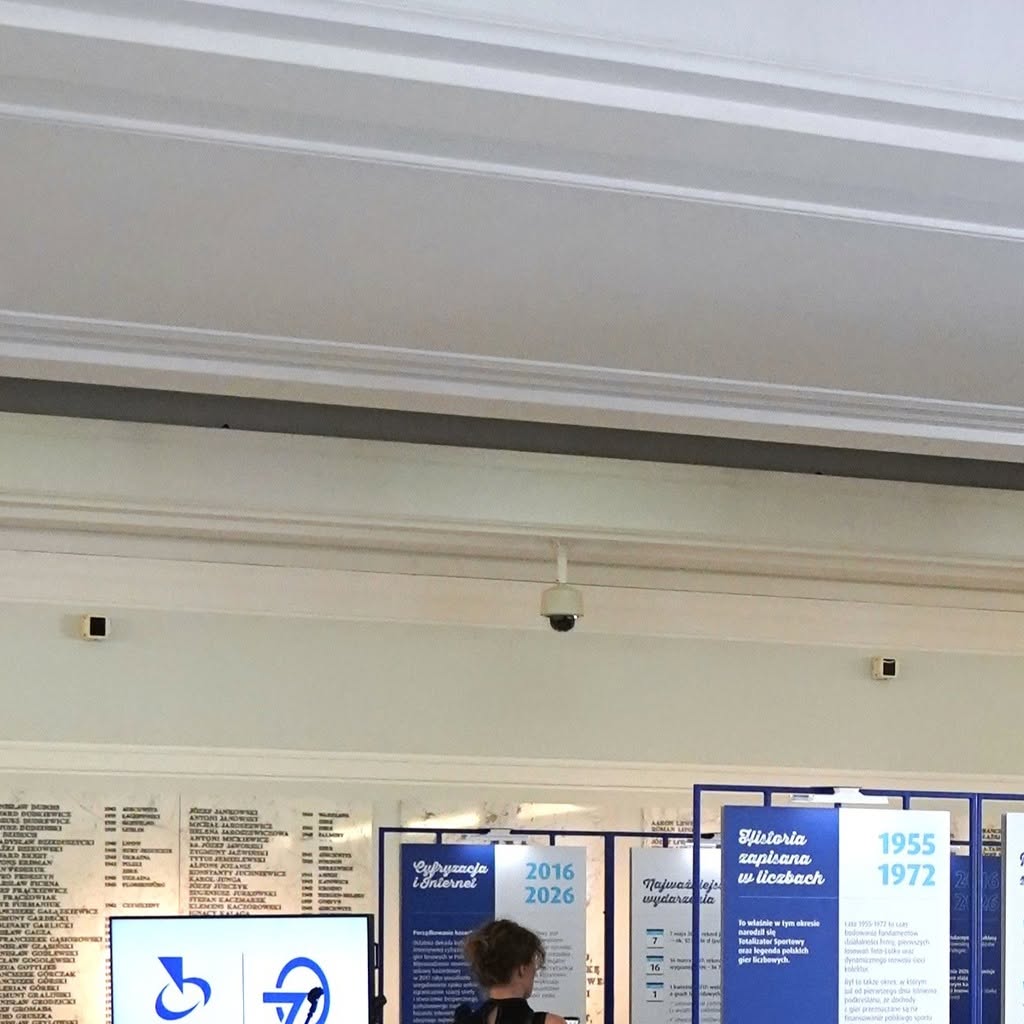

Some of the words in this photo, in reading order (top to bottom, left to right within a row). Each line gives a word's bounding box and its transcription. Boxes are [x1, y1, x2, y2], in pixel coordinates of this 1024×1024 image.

[738, 828, 808, 847] Historia
[878, 832, 936, 856] 1955
[739, 850, 813, 868] zapisana
[413, 860, 489, 878] Cyfryzacja
[525, 862, 575, 881] 2016
[738, 872, 755, 884] w
[756, 869, 826, 885] liczbach
[878, 864, 936, 887] 1972
[412, 876, 419, 889] i
[420, 877, 479, 889] Internet
[525, 886, 575, 904] 2026
[747, 919, 773, 927] właśnie
[782, 920, 795, 928] tym
[774, 938, 805, 947] Sportowy
[754, 947, 781, 956] legenda
[782, 947, 809, 955] polskich
[651, 964, 661, 972] 16
[738, 957, 752, 965] gier
